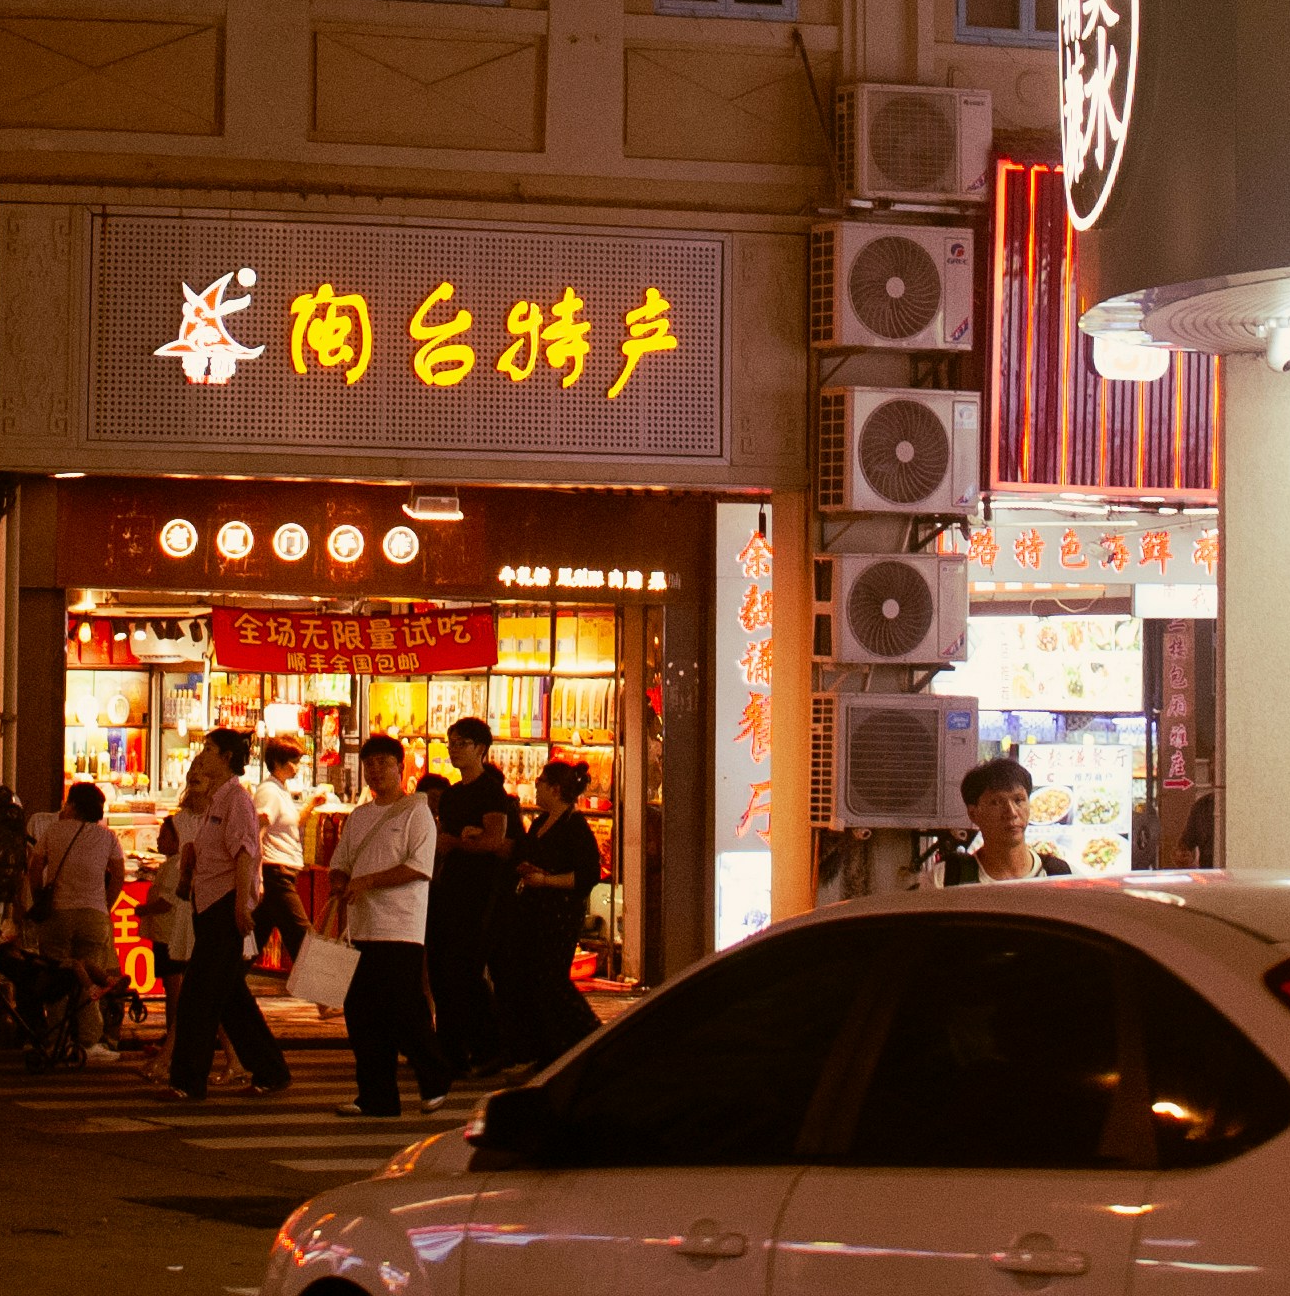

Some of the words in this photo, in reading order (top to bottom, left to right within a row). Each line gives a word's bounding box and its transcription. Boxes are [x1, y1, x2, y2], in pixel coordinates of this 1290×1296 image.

[290, 281, 679, 399] 闽台特产
[234, 612, 472, 651] 全场无限量试吃
[286, 651, 420, 674] 顺丰全国包邮
